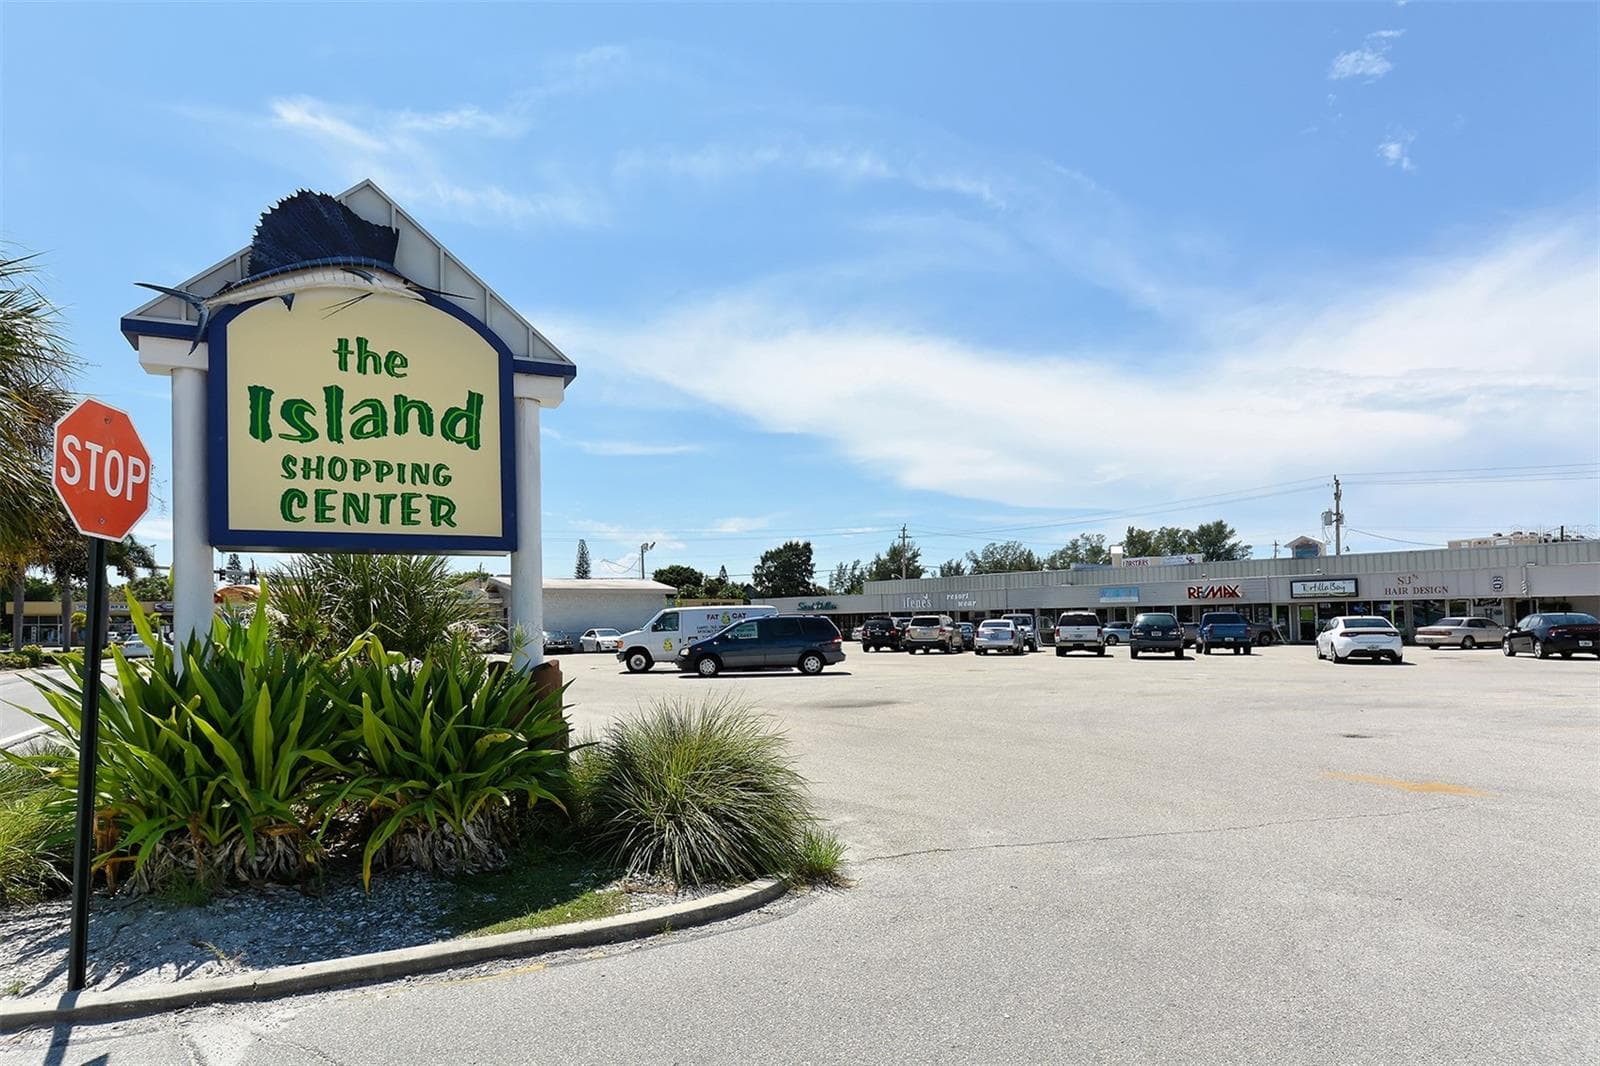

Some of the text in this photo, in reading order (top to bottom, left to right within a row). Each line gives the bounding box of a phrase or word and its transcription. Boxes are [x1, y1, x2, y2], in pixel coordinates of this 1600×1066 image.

[332, 337, 408, 378] the
[247, 385, 484, 451] Island
[60, 434, 146, 501] STOP
[280, 454, 453, 487] SHOPPING
[279, 488, 457, 528] CENTER
[946, 592, 969, 601] resort
[1384, 586, 1449, 595] HAIR DESIGN
